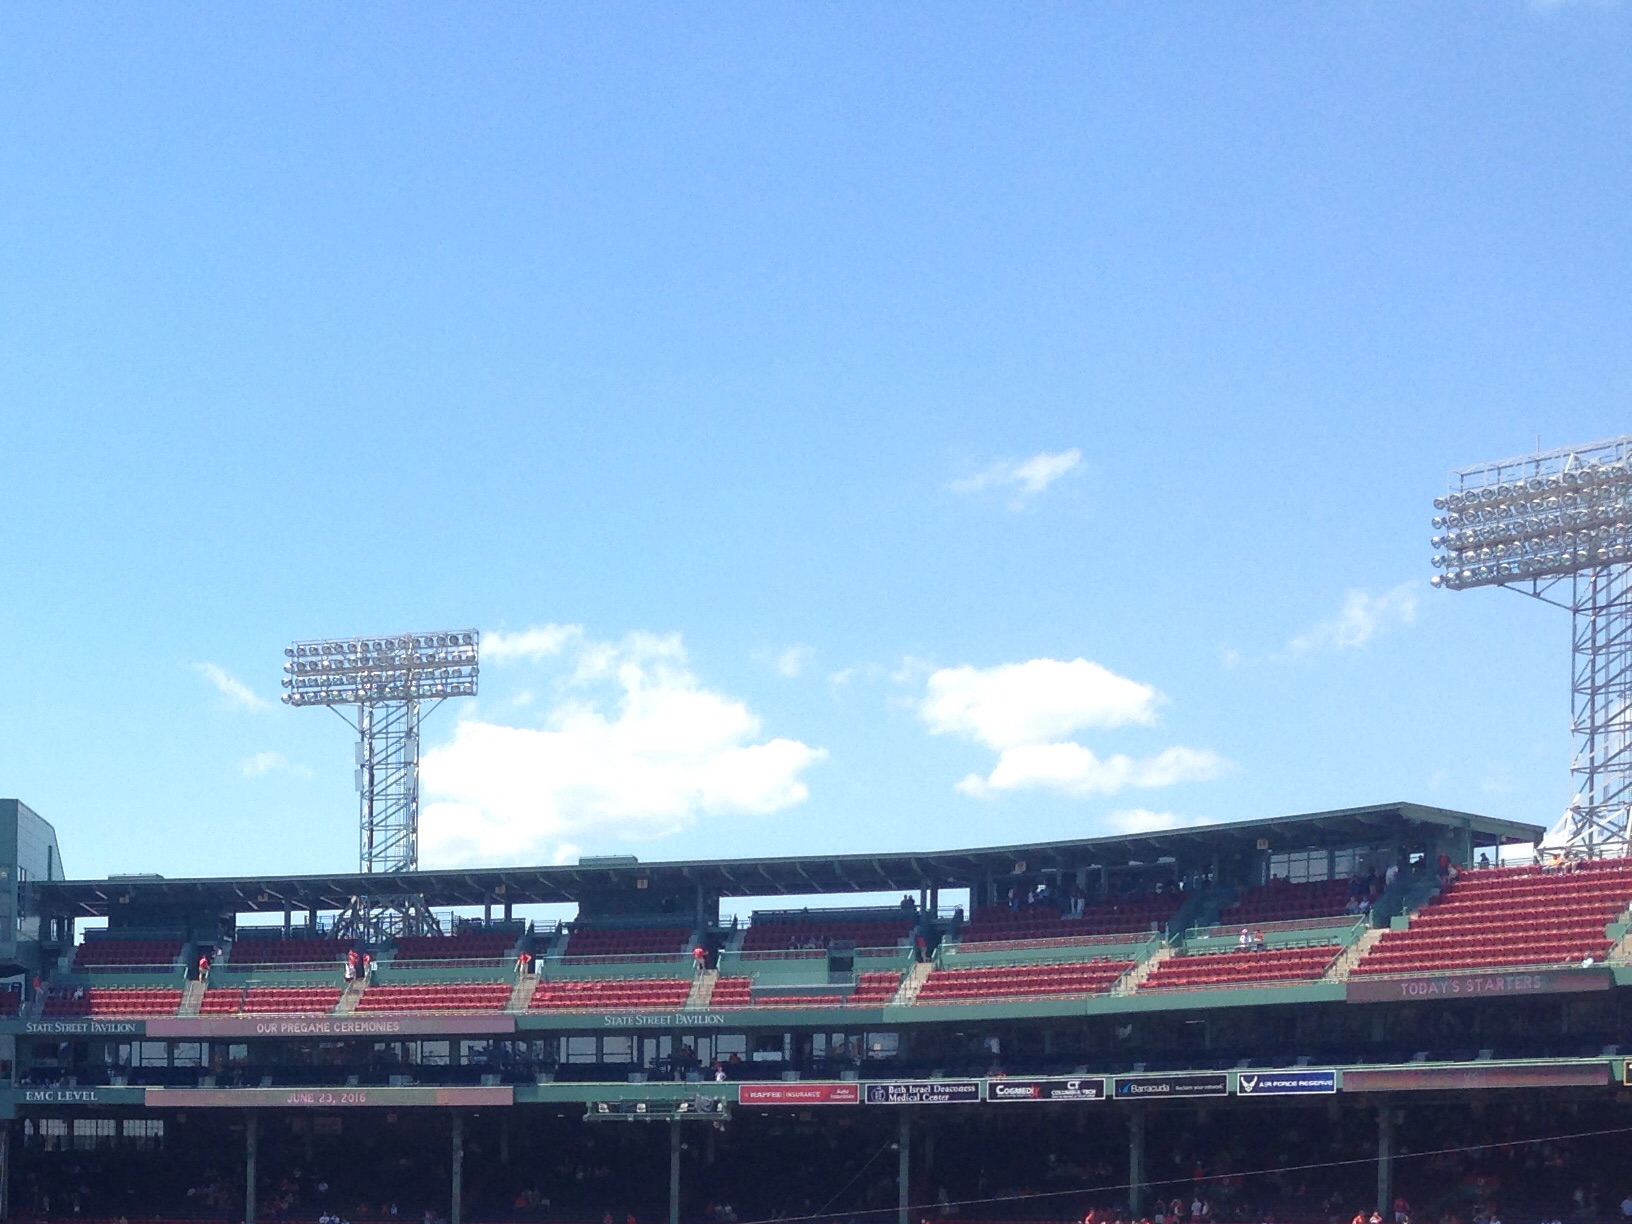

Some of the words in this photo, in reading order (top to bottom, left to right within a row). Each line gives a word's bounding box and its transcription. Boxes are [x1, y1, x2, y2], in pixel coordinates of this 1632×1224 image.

[1401, 979, 1460, 995] TODAY'S
[1466, 975, 1541, 992] STARTERS
[604, 1015, 633, 1025] STATE
[636, 1015, 671, 1025] STREET
[676, 1014, 724, 1025] PAVILION
[26, 1022, 54, 1032] STATE
[55, 1022, 88, 1033] STREET
[91, 1021, 136, 1032] PAVILION
[257, 1023, 278, 1033] OUR
[281, 1022, 330, 1033] PREGAME
[334, 1021, 400, 1032] CEREMONIES
[888, 1086, 907, 1094] Beth
[909, 1085, 930, 1093] Israel
[934, 1084, 976, 1093] Deaconess
[26, 1091, 53, 1101] EMC
[57, 1091, 98, 1101] LEVEL
[287, 1093, 314, 1103] JUNE
[319, 1093, 336, 1105] 23,
[341, 1092, 366, 1103] 2016
[888, 1094, 919, 1102] Medical
[922, 1093, 949, 1102] Center
